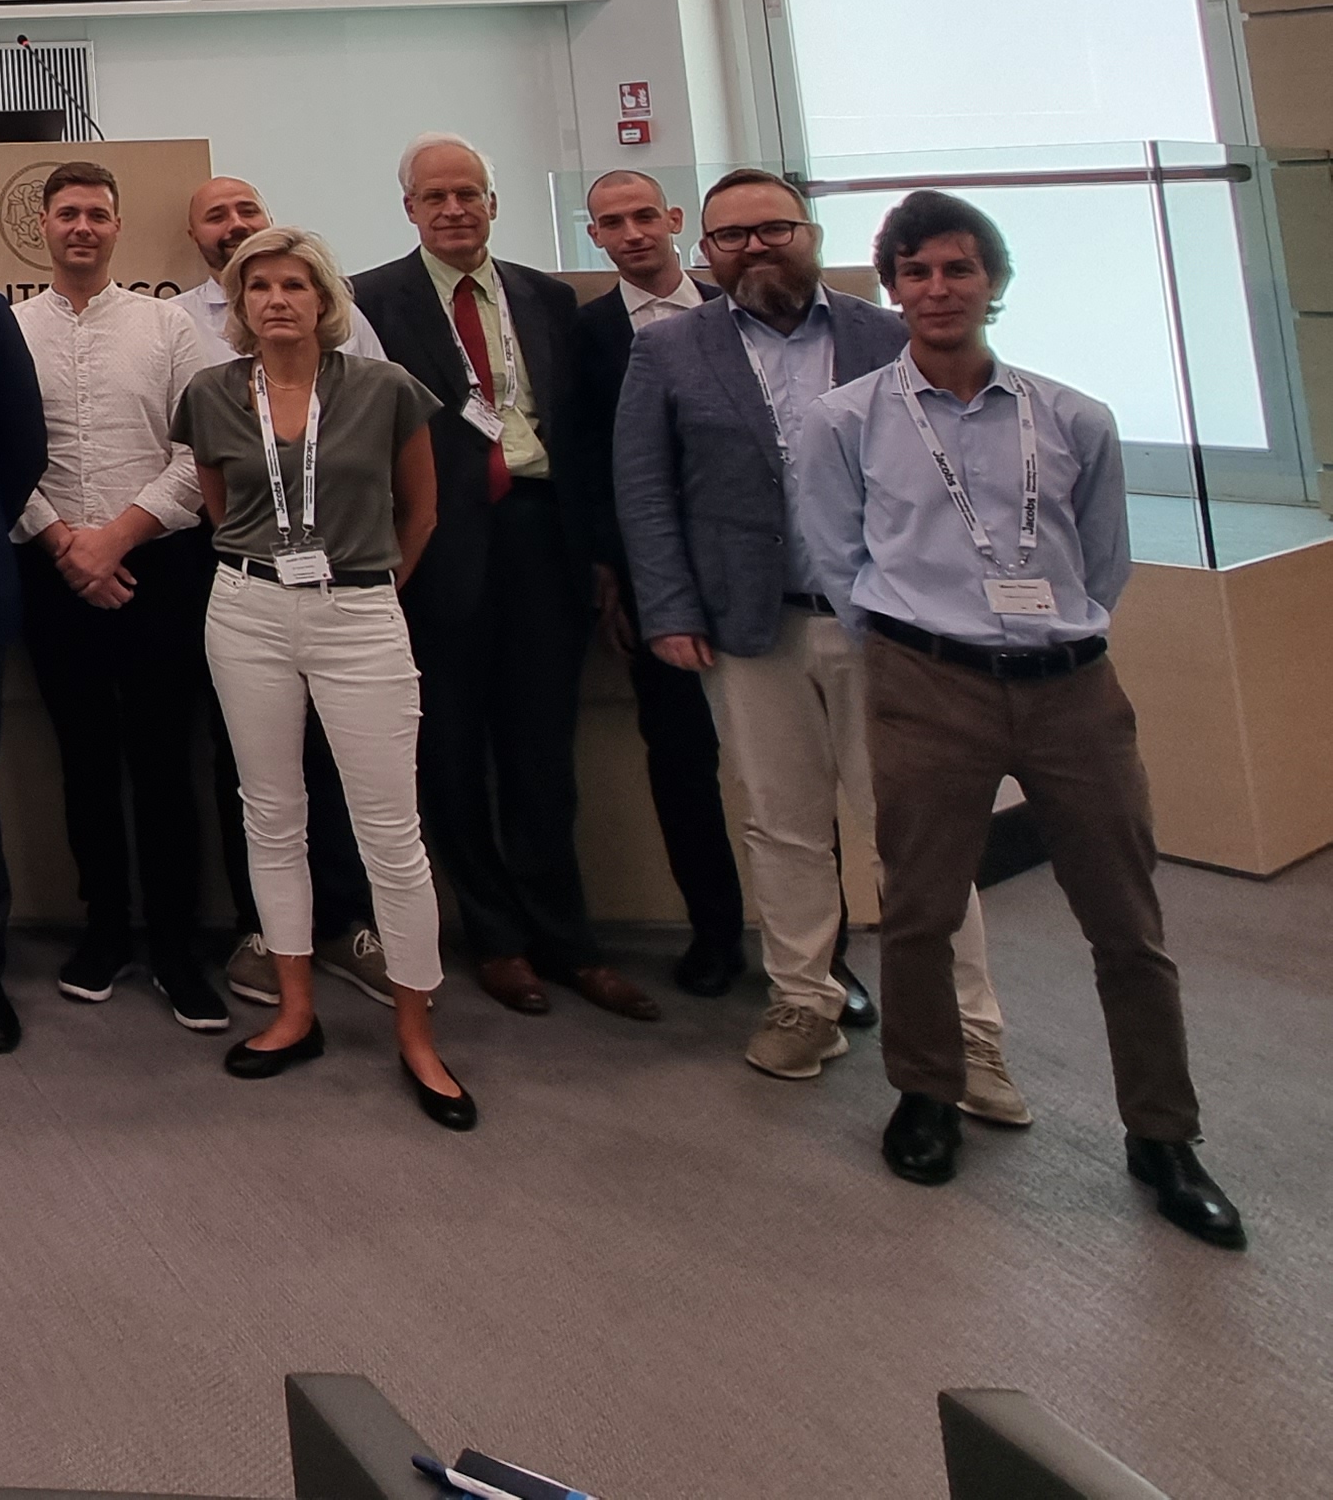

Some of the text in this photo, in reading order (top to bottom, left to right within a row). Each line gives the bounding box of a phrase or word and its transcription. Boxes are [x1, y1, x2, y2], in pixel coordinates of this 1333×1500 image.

[306, 439, 317, 471] Jacobs
[932, 450, 956, 487] Jacobs
[273, 481, 286, 514] Jacobs
[1022, 497, 1036, 535] Jacobs
